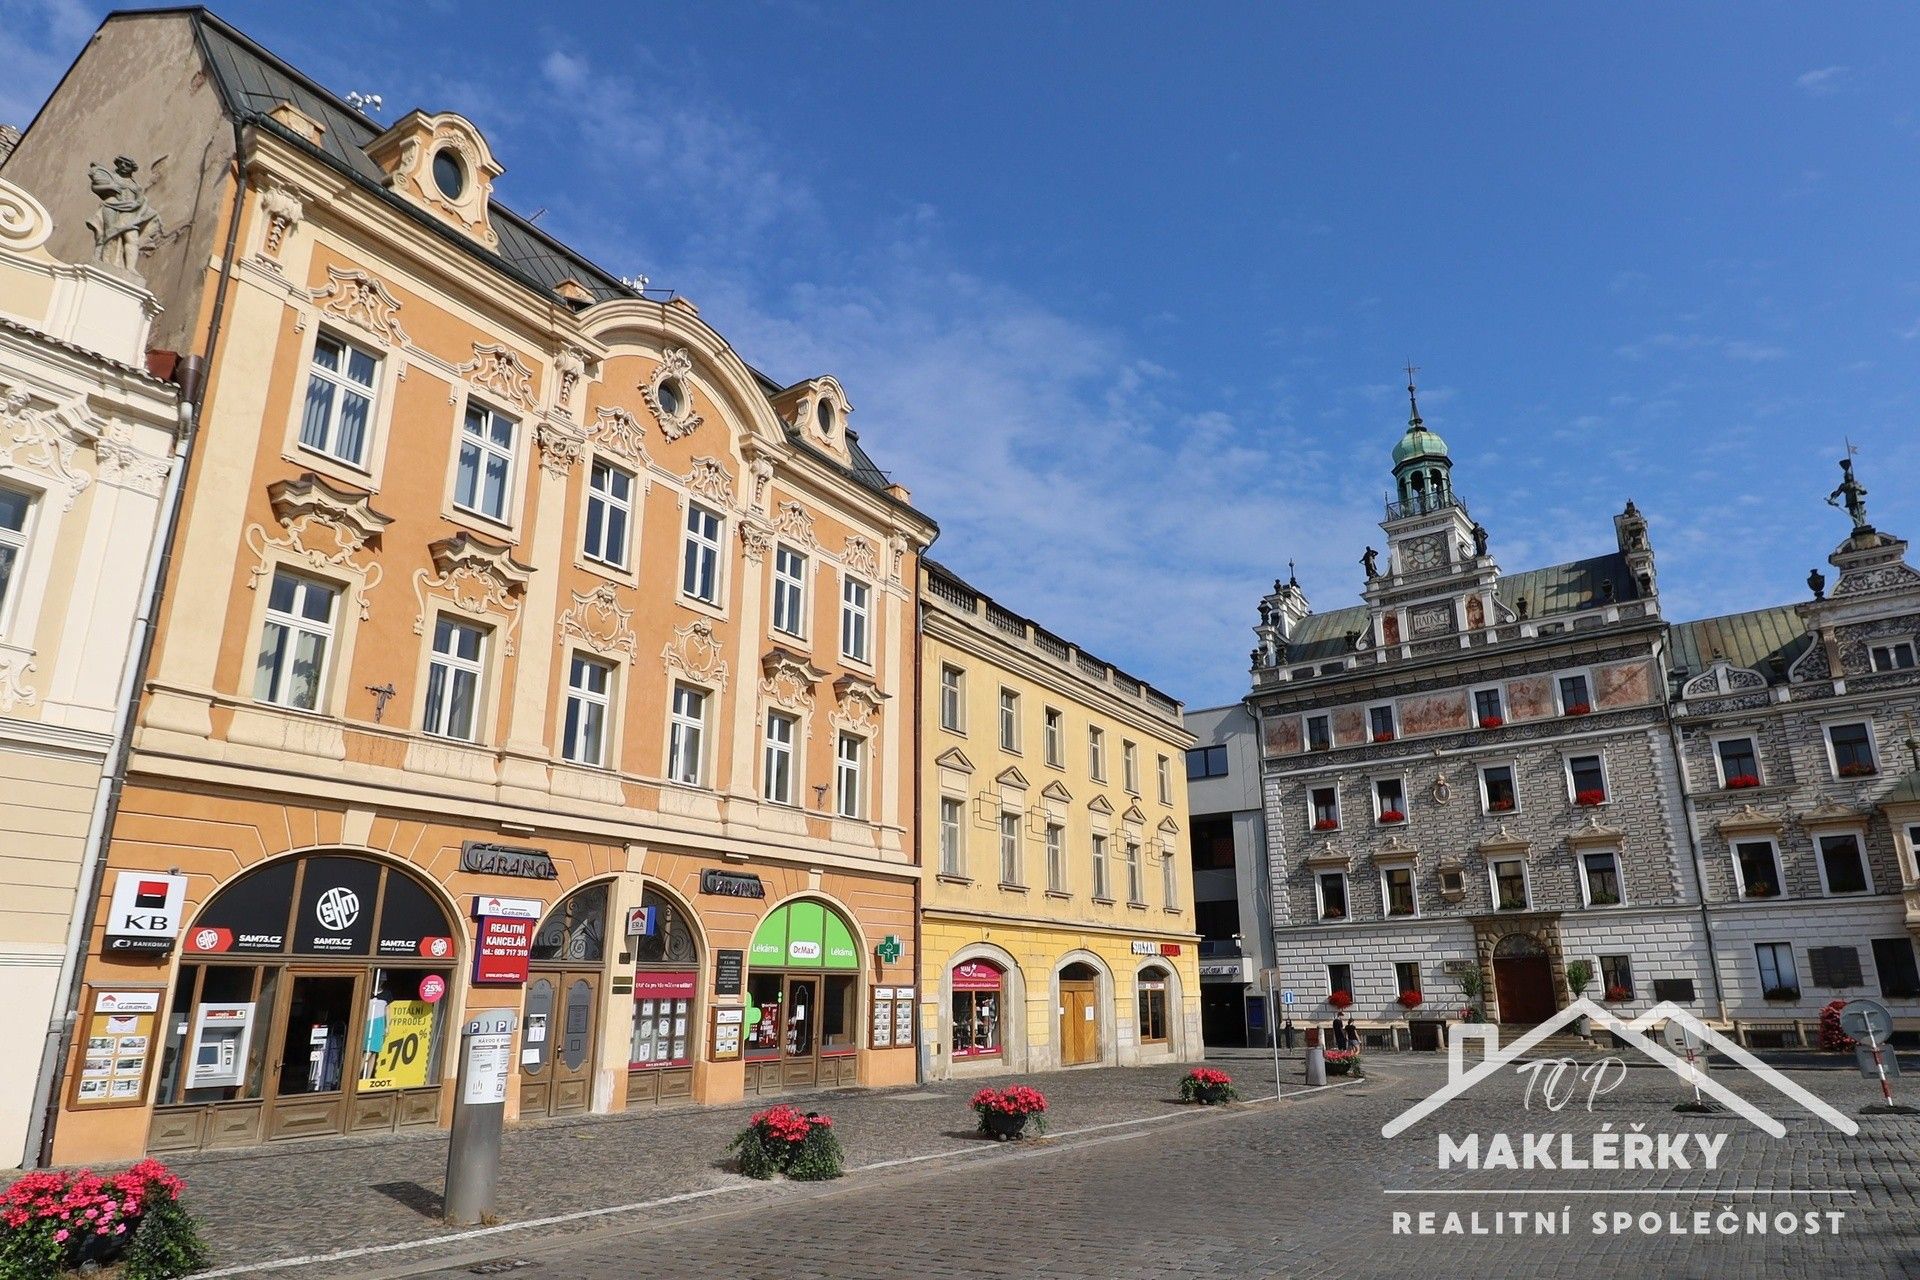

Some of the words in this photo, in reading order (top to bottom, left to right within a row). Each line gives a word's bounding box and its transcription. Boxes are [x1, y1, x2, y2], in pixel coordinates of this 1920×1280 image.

[124, 914, 168, 930] KB
[490, 923, 526, 934] REALITNÍ
[238, 934, 282, 943] SAM73.CZ
[313, 937, 352, 946] SAM73.CZ
[380, 939, 416, 947] SAM73.CZ
[486, 935, 527, 947] KANCELÁŘ
[517, 949, 528, 957] 310
[471, 1022, 479, 1033] P
[497, 1021, 505, 1032] P
